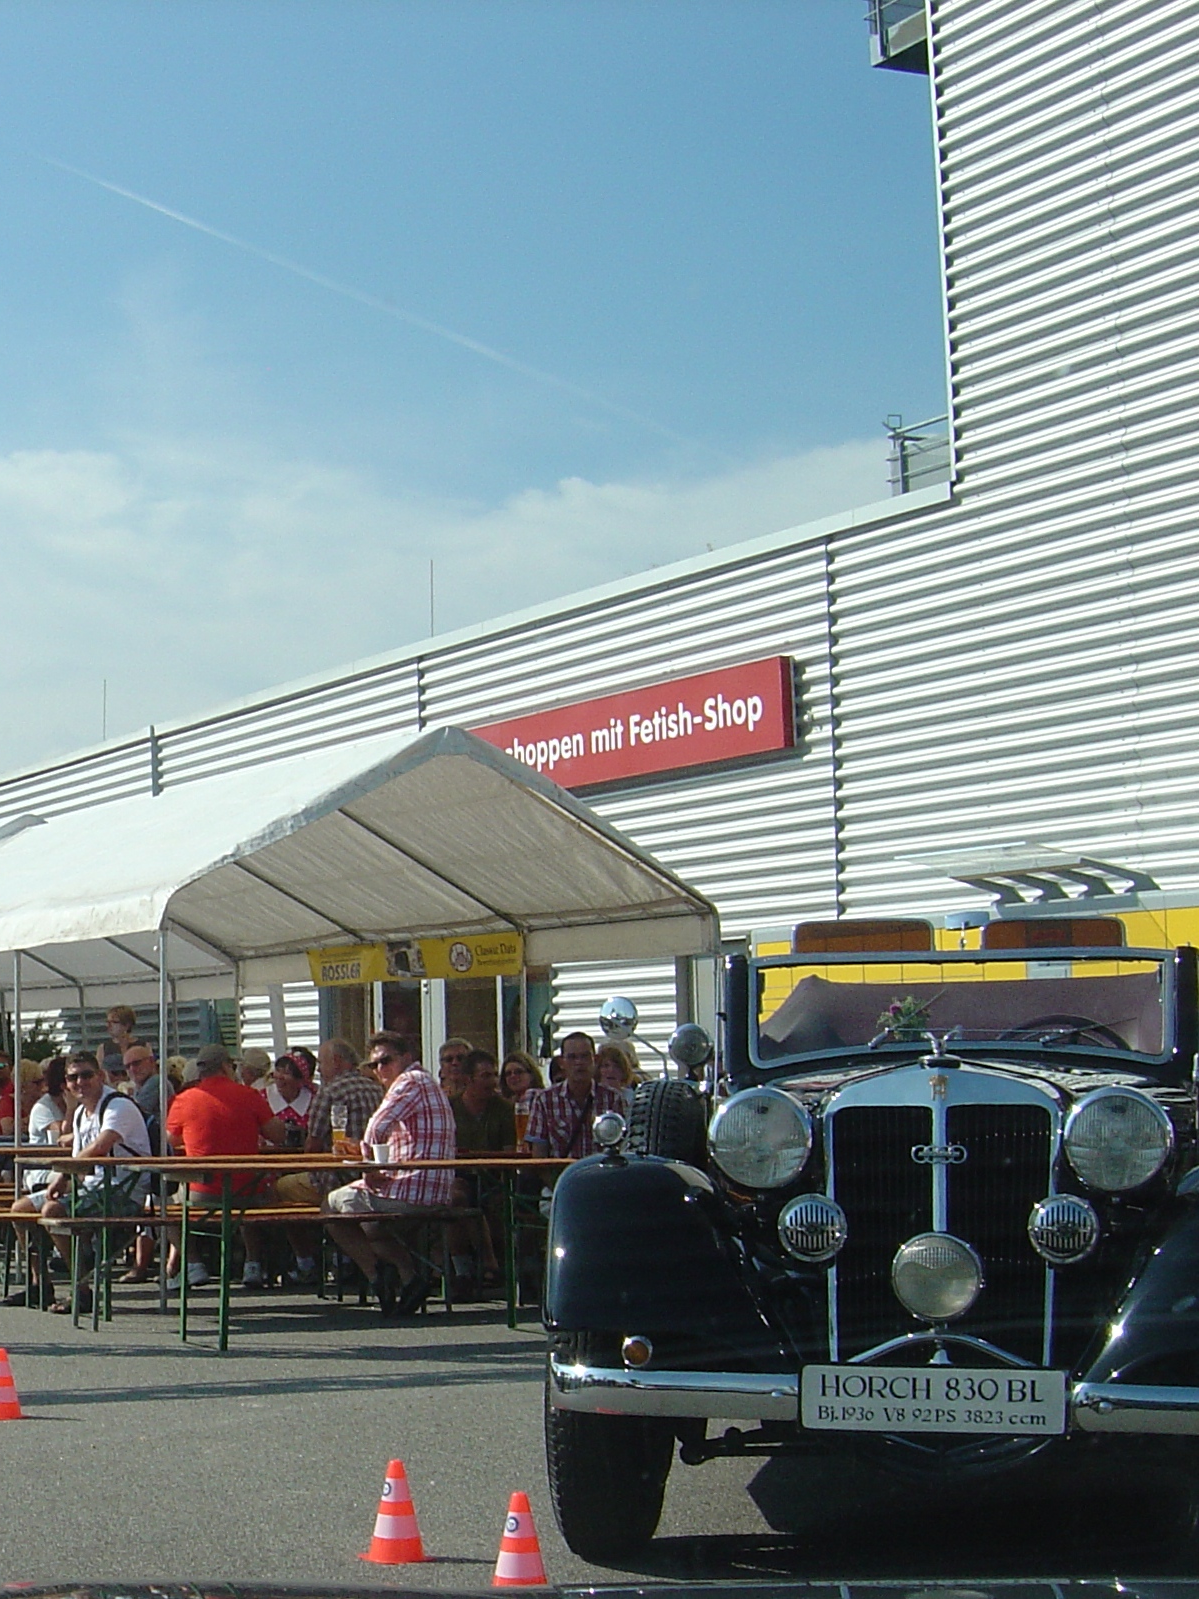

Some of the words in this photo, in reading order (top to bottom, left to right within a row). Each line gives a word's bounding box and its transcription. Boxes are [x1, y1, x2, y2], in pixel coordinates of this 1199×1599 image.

[505, 734, 584, 772] hoppen
[591, 718, 624, 754] mit
[629, 693, 763, 745] Fetish-Shop
[820, 1373, 931, 1400] HORCH
[945, 1377, 999, 1400] 830
[1007, 1379, 1045, 1403] BL
[883, 1407, 906, 1423] V8
[963, 1410, 1004, 1425] 3823
[1009, 1414, 1047, 1426] ccm
